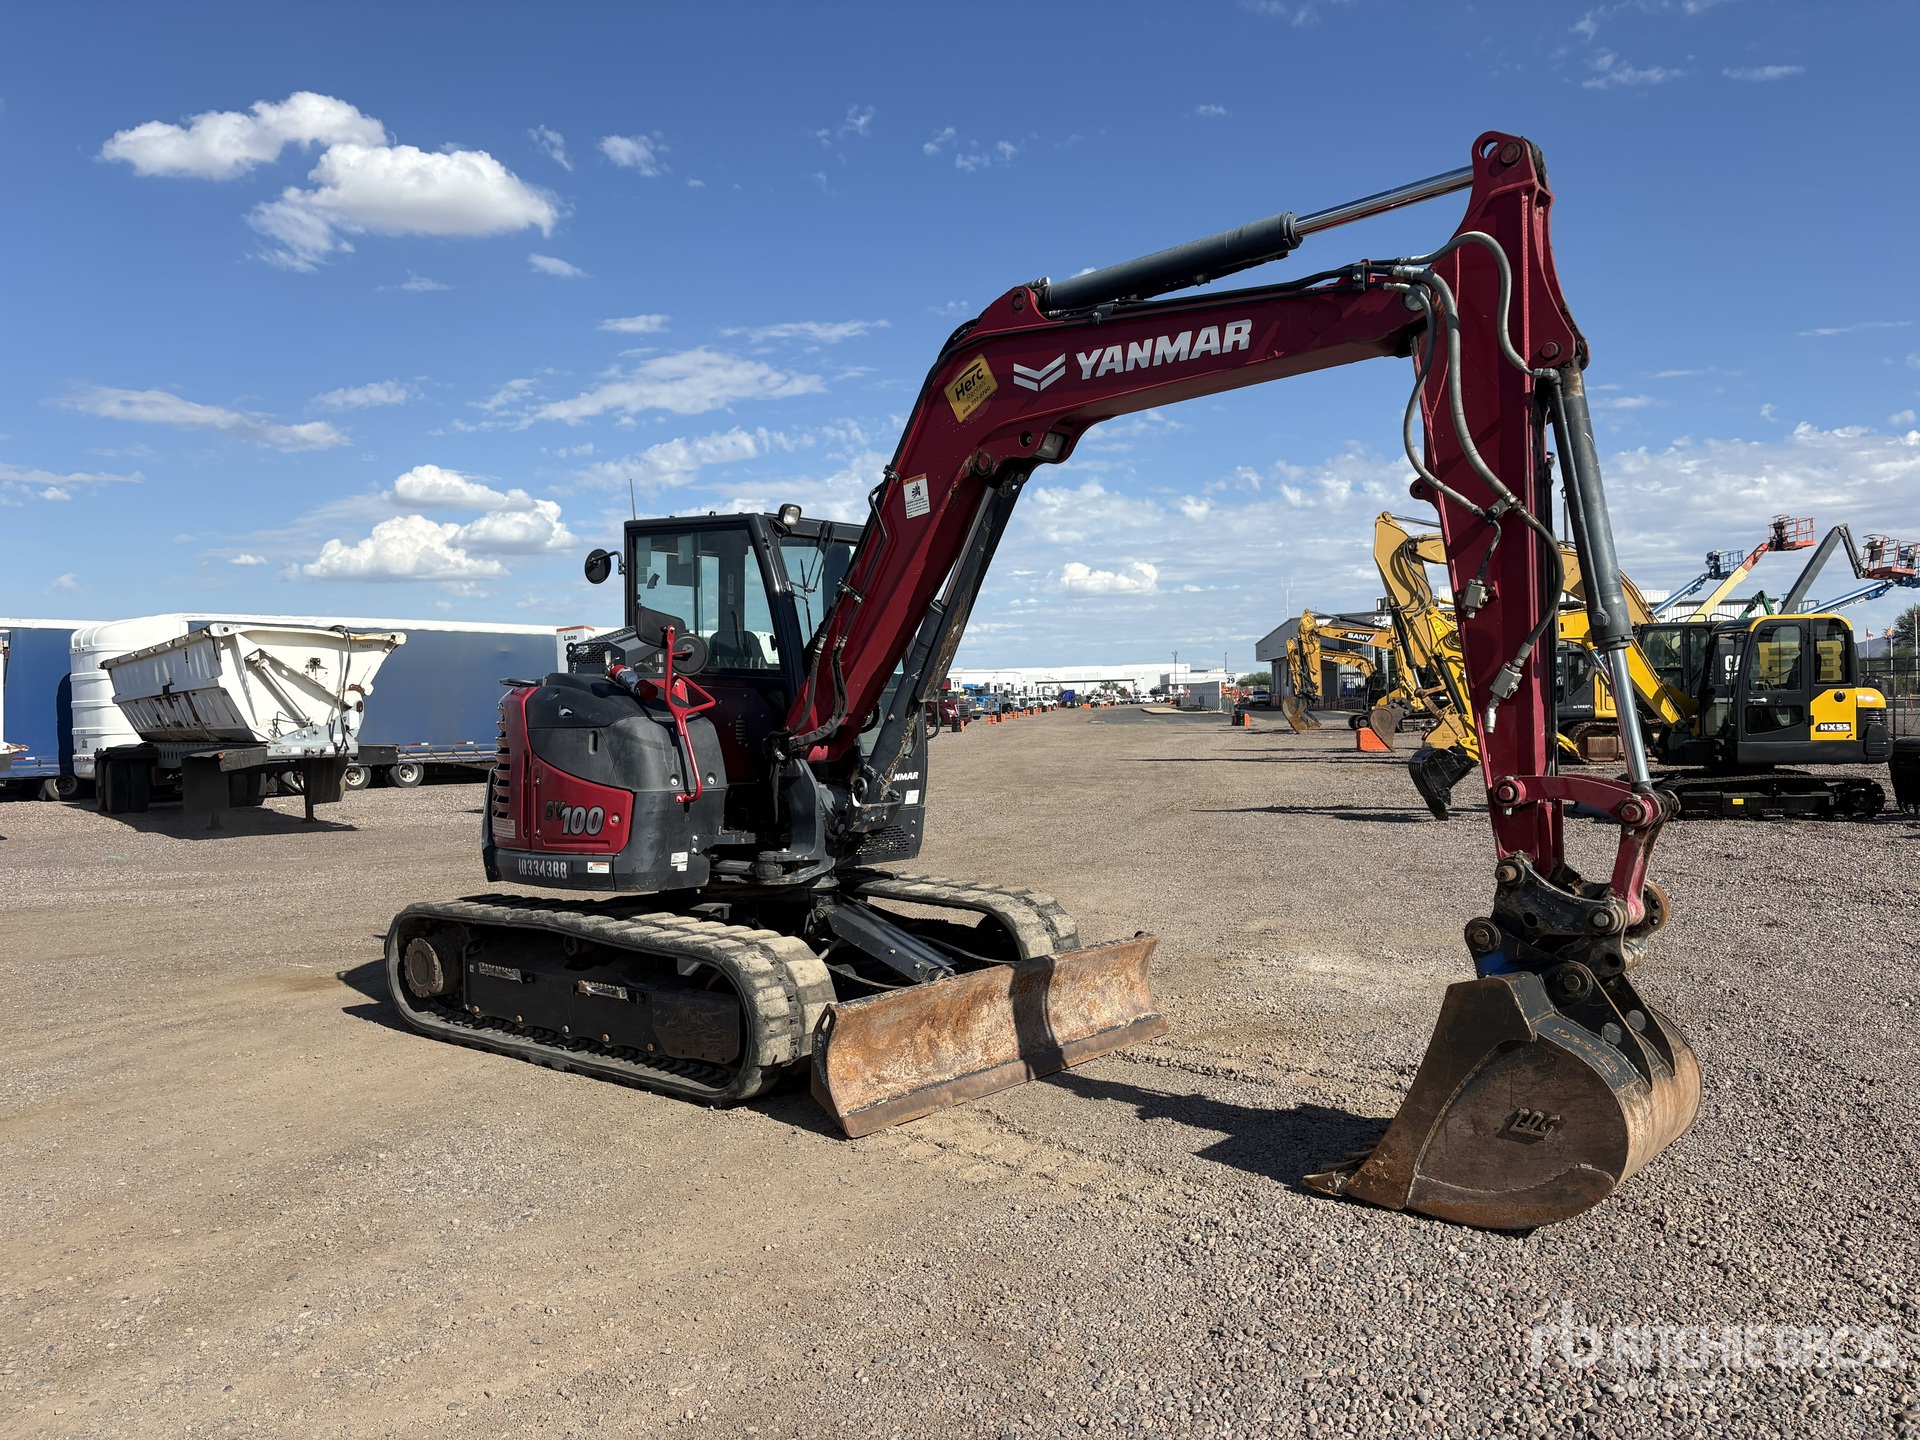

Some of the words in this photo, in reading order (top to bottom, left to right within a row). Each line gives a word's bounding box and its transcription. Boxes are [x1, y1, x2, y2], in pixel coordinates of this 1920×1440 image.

[1076, 319, 1253, 380] YANMAR
[955, 368, 984, 401] Herc
[966, 380, 987, 400] Rentals
[1347, 632, 1371, 641] SANY
[952, 680, 960, 688] 11
[1820, 723, 1850, 731] HX55
[893, 771, 919, 782] NMAR
